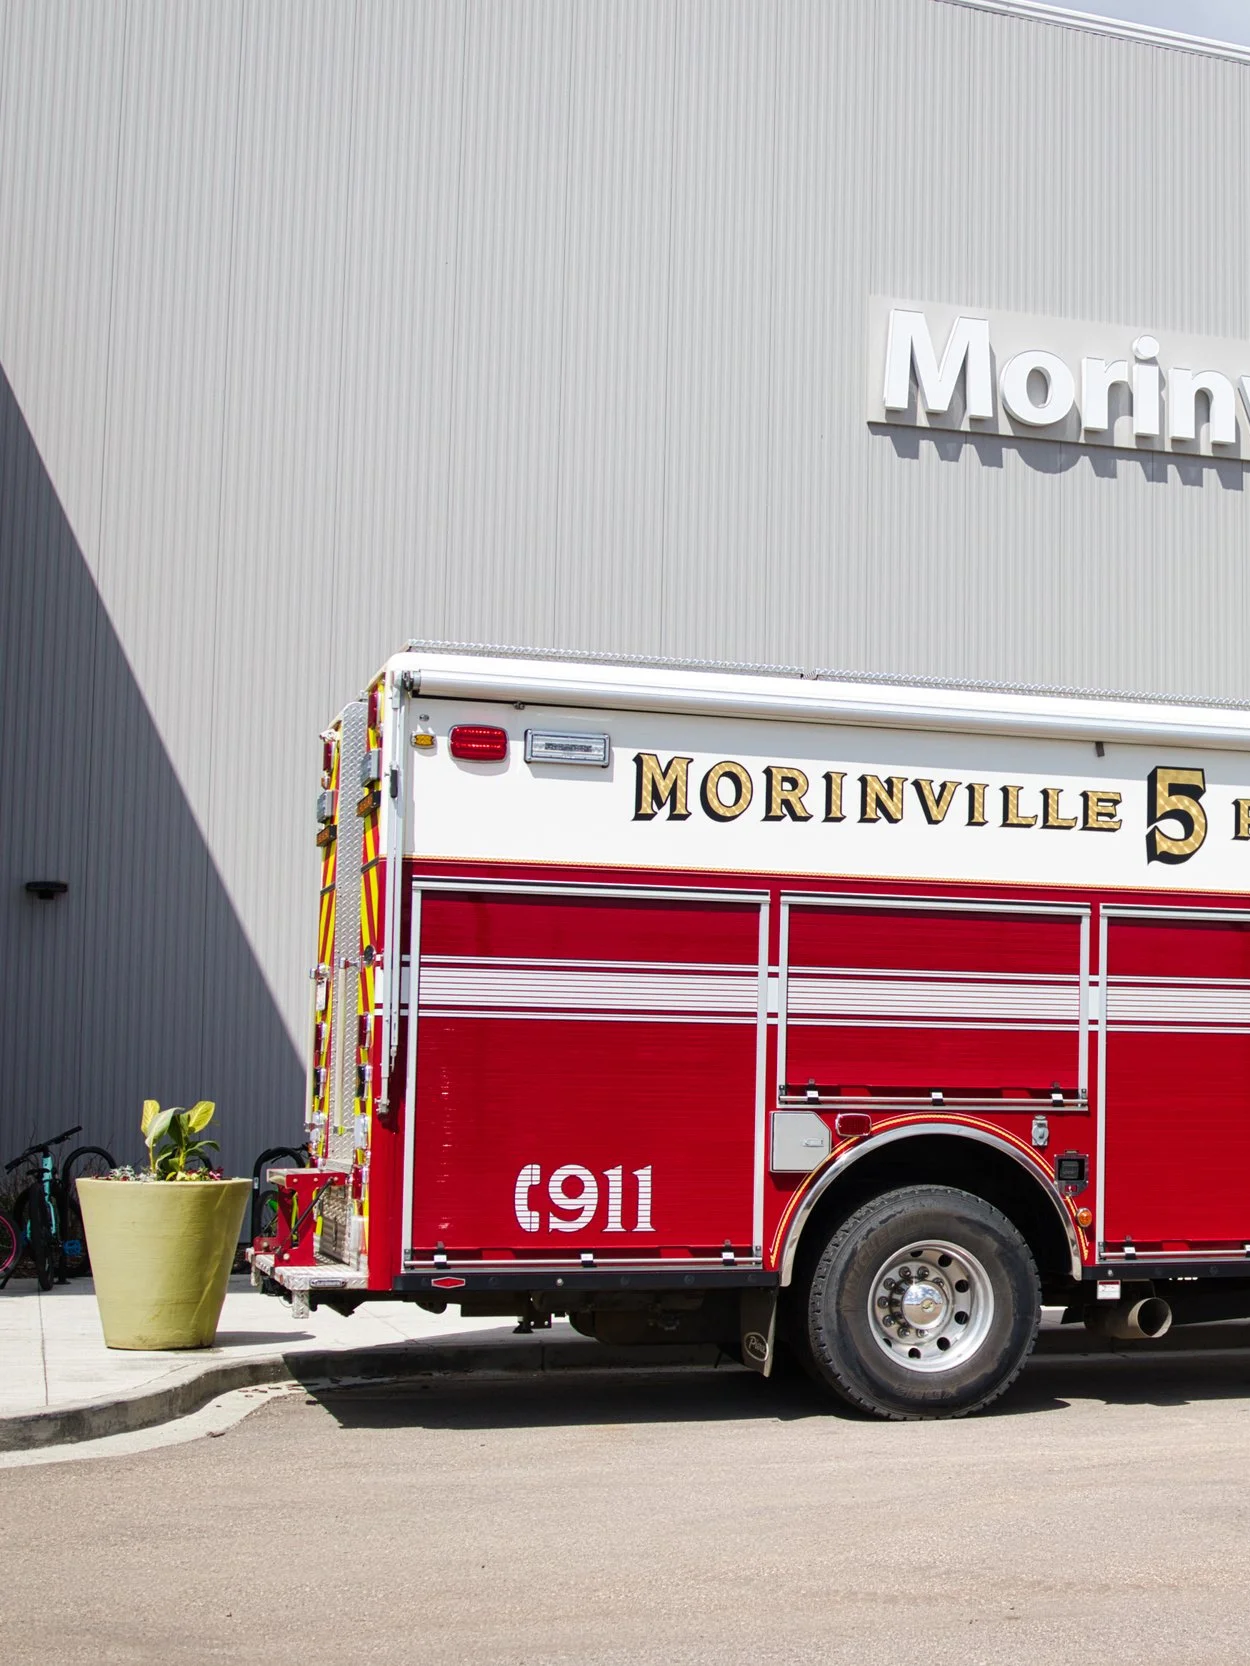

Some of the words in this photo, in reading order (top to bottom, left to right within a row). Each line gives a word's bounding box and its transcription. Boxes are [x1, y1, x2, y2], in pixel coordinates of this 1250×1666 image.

[631, 752, 1123, 832] MORINVILLE
[1146, 766, 1208, 865] 5
[548, 1163, 657, 1233] 911
